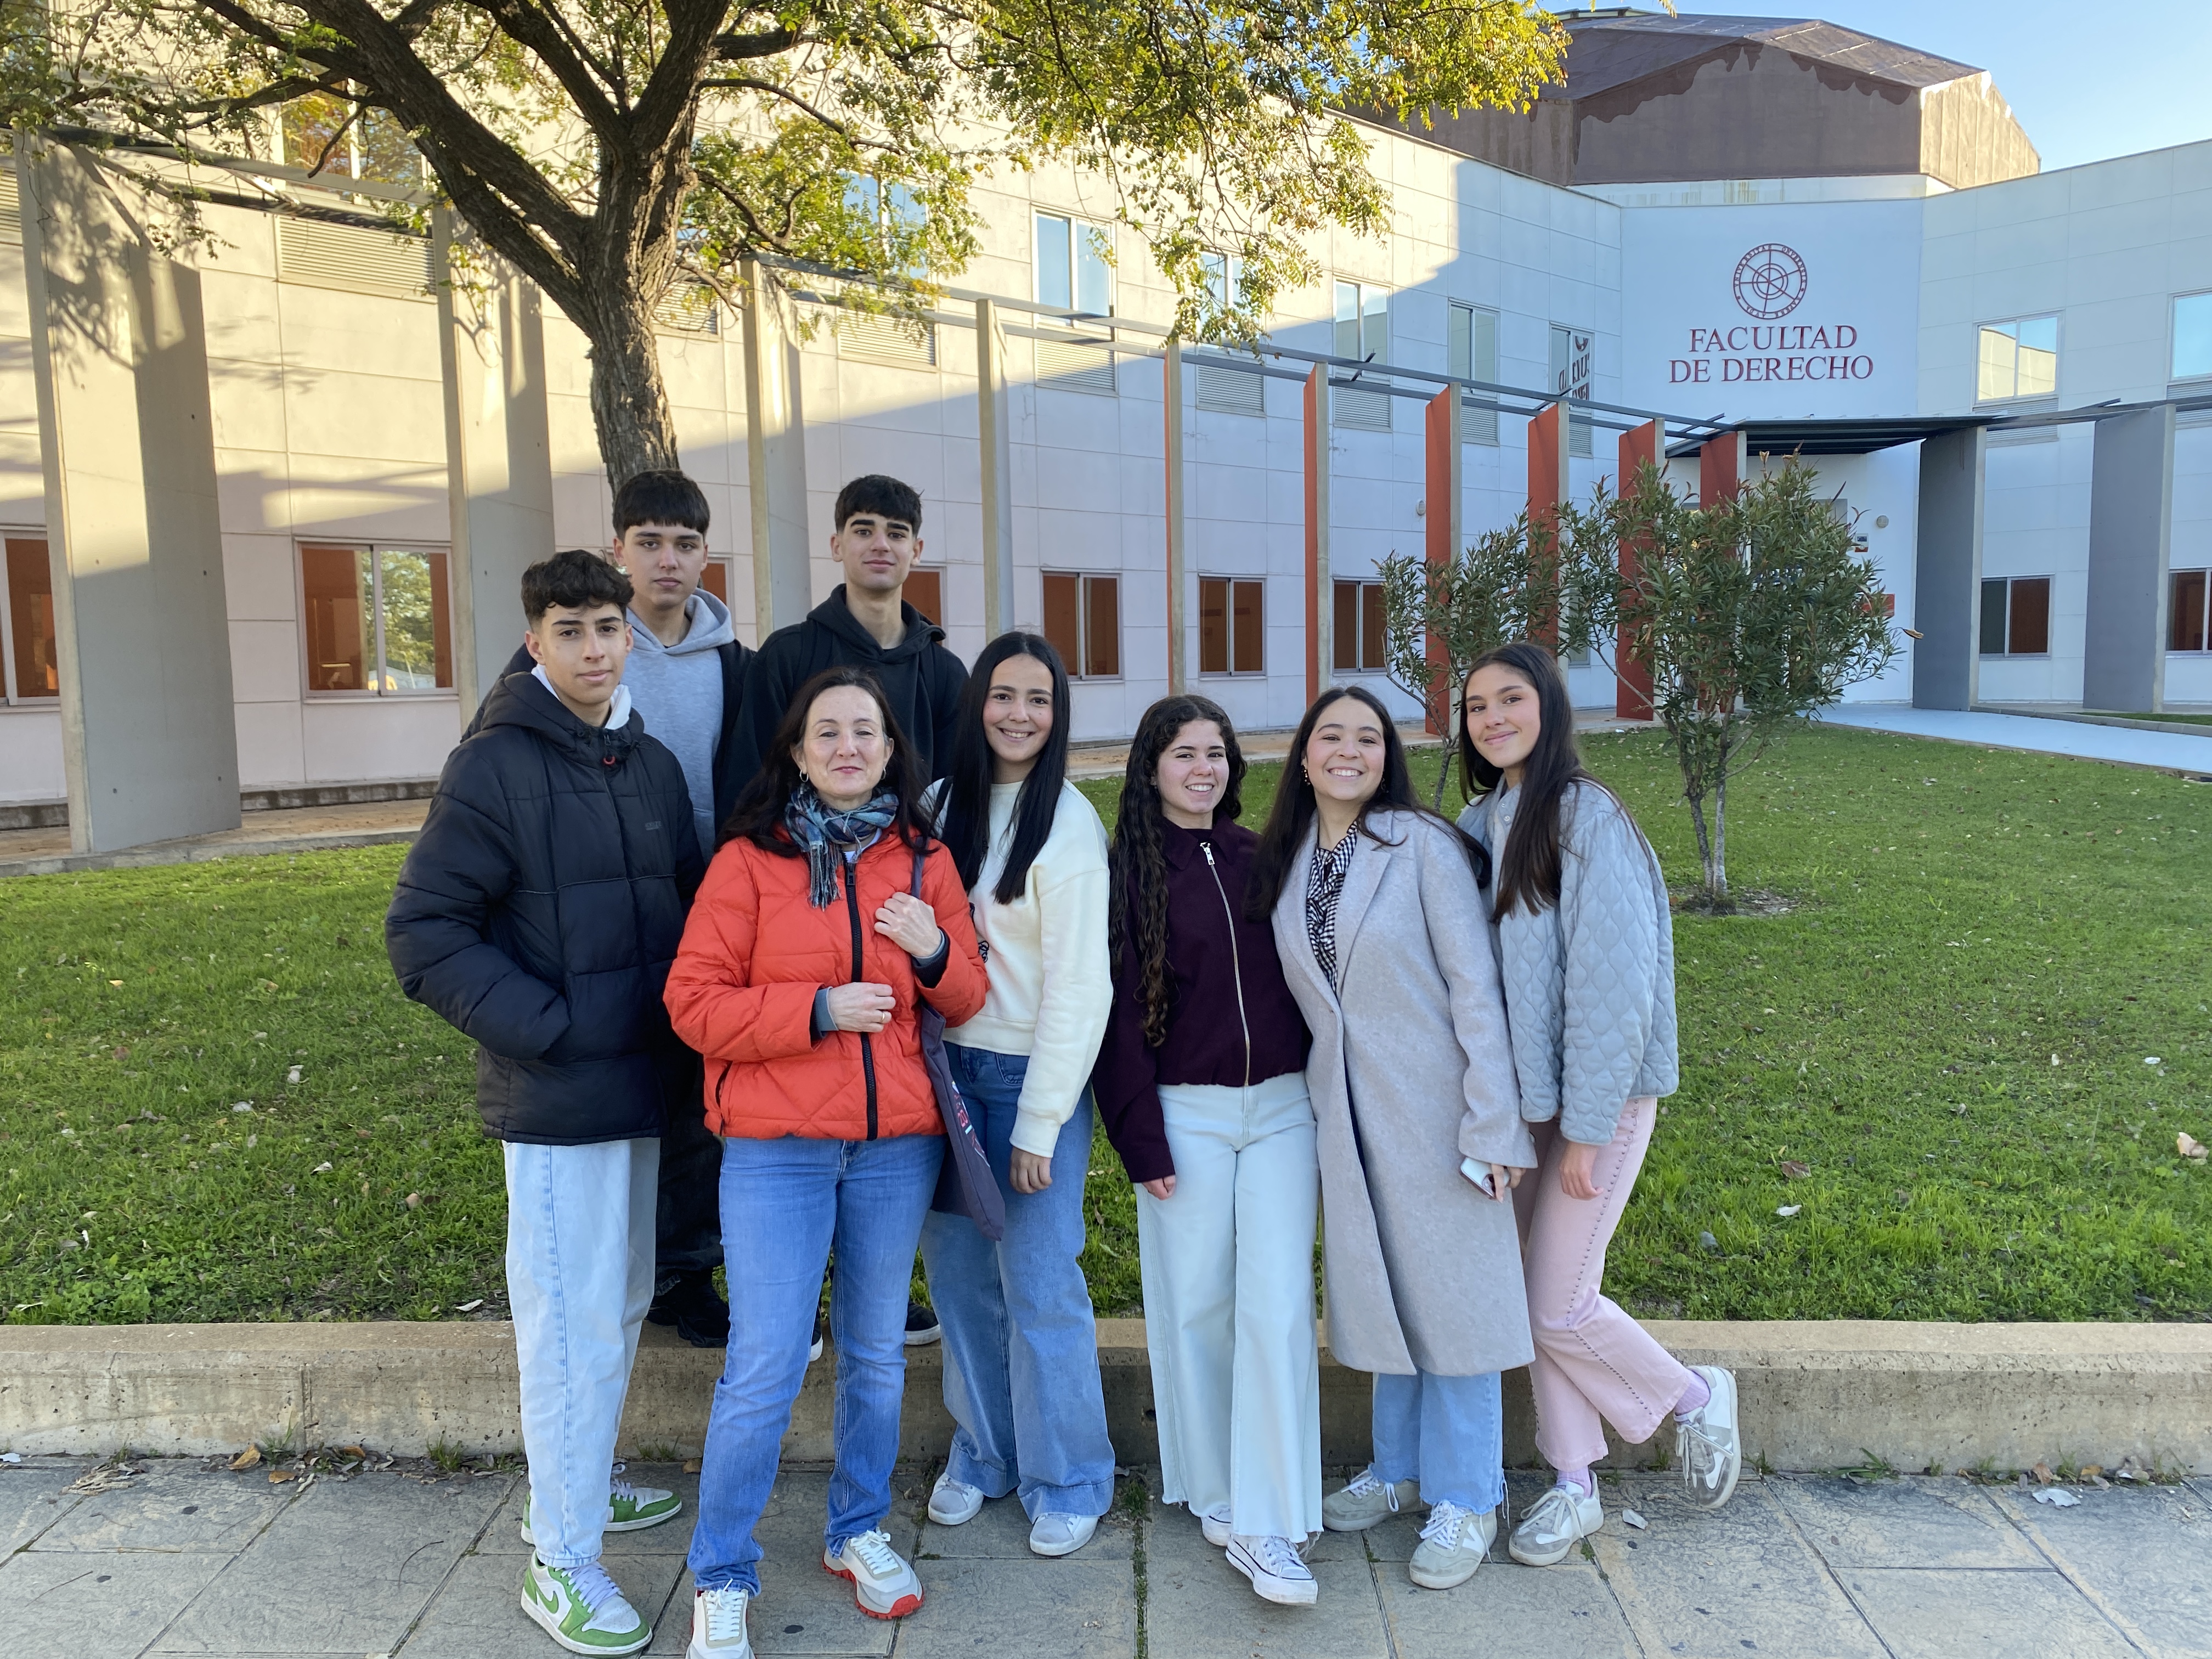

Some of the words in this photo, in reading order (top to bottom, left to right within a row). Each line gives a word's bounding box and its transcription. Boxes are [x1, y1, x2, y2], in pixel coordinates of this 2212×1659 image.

[1689, 325, 1858, 352] FACULTAD
[1668, 359, 1711, 383] DE
[1721, 355, 1874, 382] DERECHO
